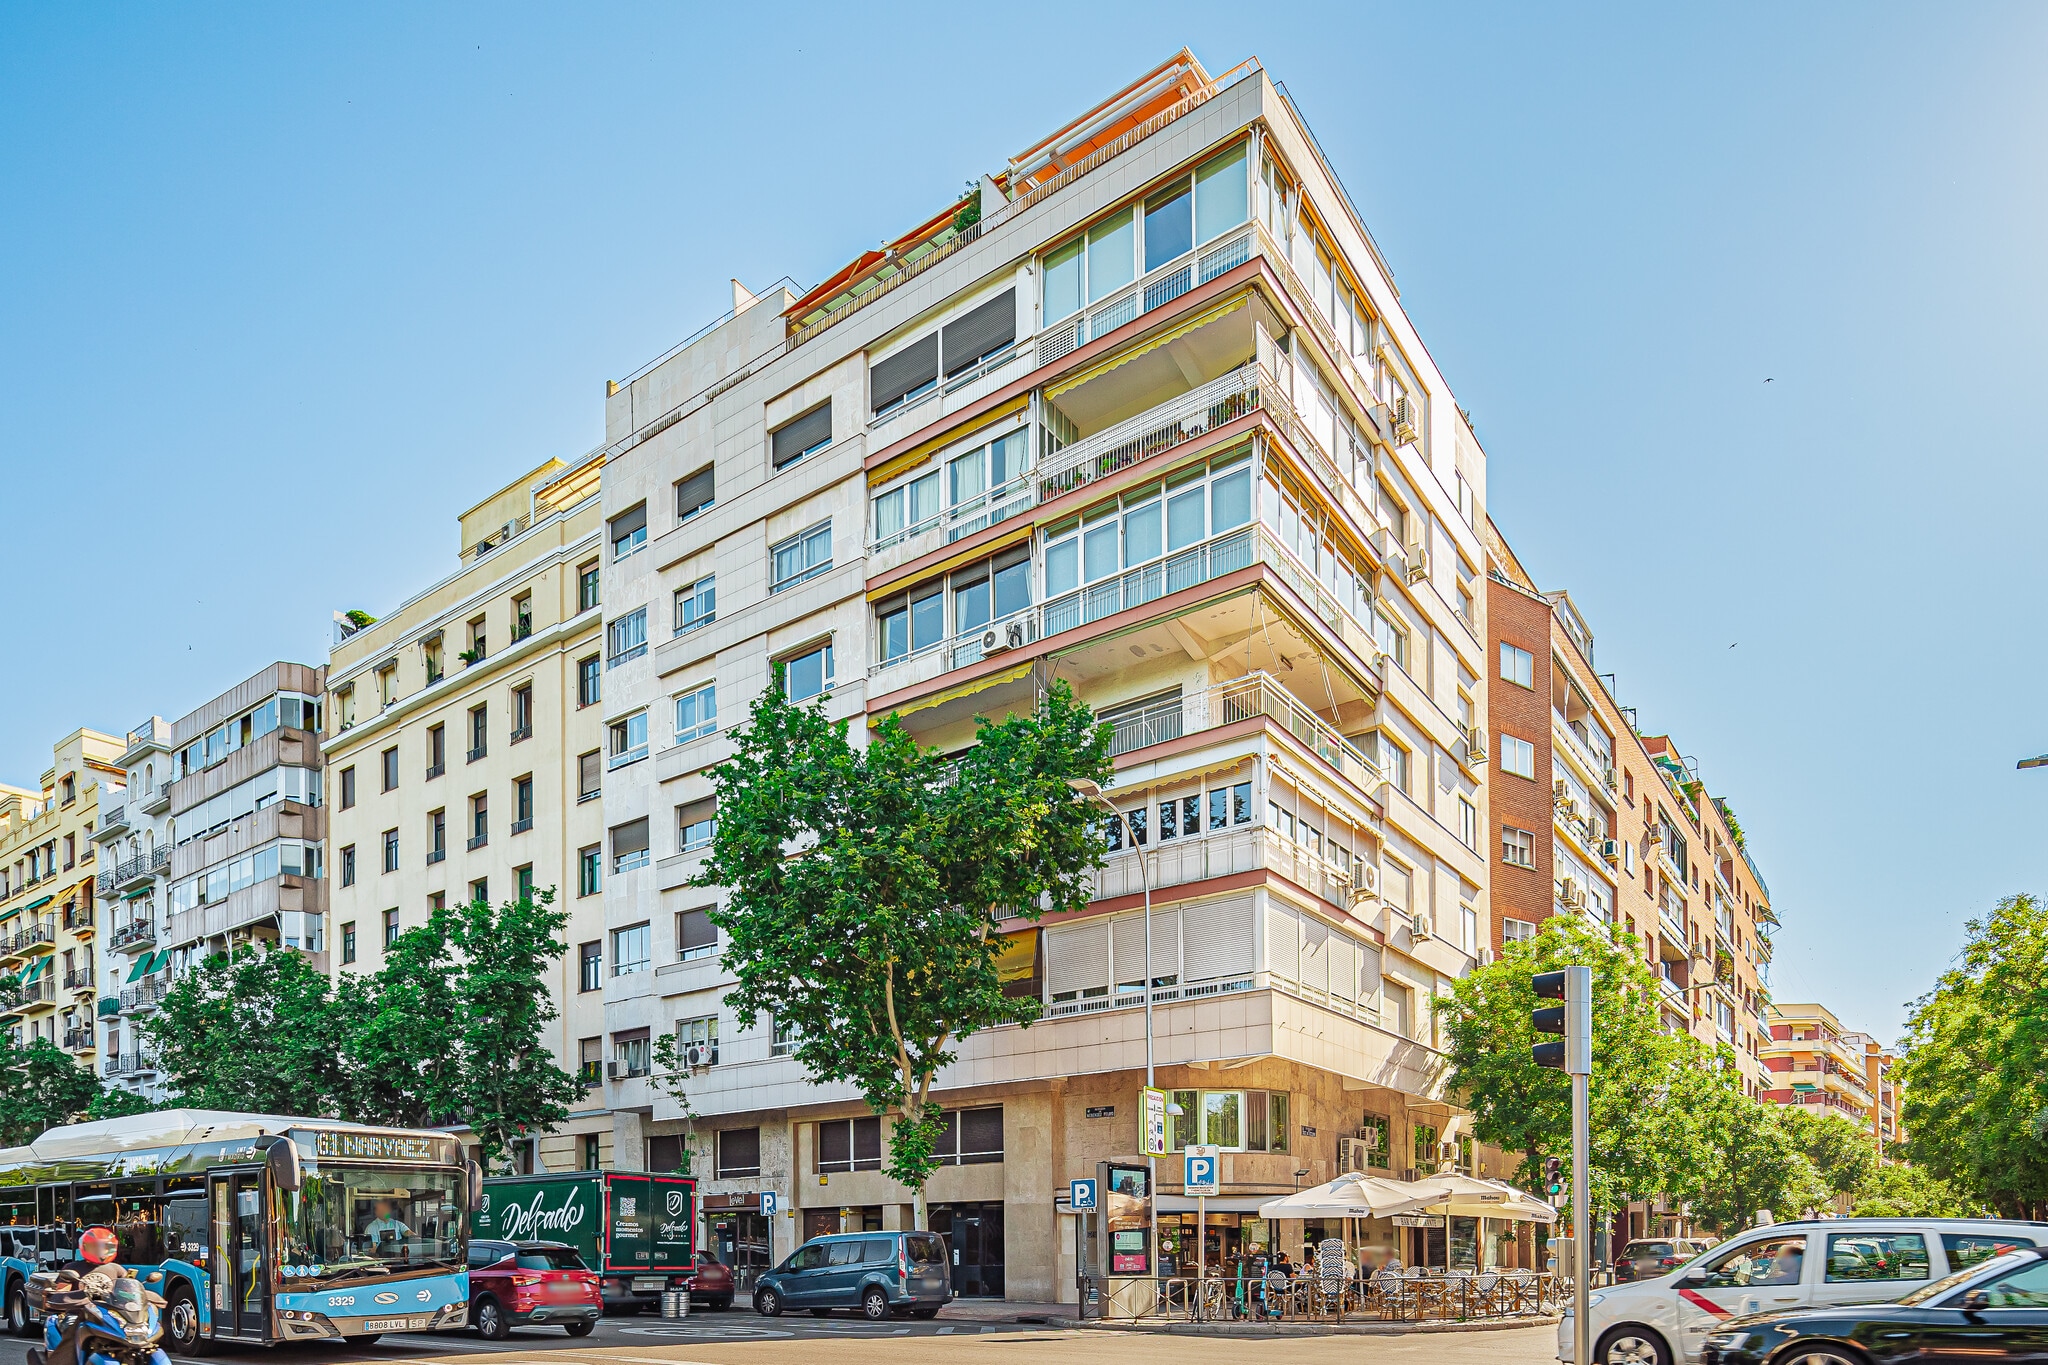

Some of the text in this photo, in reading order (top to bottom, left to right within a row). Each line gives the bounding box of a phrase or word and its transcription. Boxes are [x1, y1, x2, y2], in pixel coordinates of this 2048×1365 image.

[344, 1136, 430, 1158] NARVAEZ
[1191, 1159, 1210, 1184] P
[763, 1194, 774, 1215] P
[1074, 1183, 1090, 1206] P
[500, 1185, 585, 1240] Delgado
[328, 1296, 355, 1307] 3329
[369, 1320, 403, 1330] 8808 LVL
[411, 1319, 424, 1328] SP
